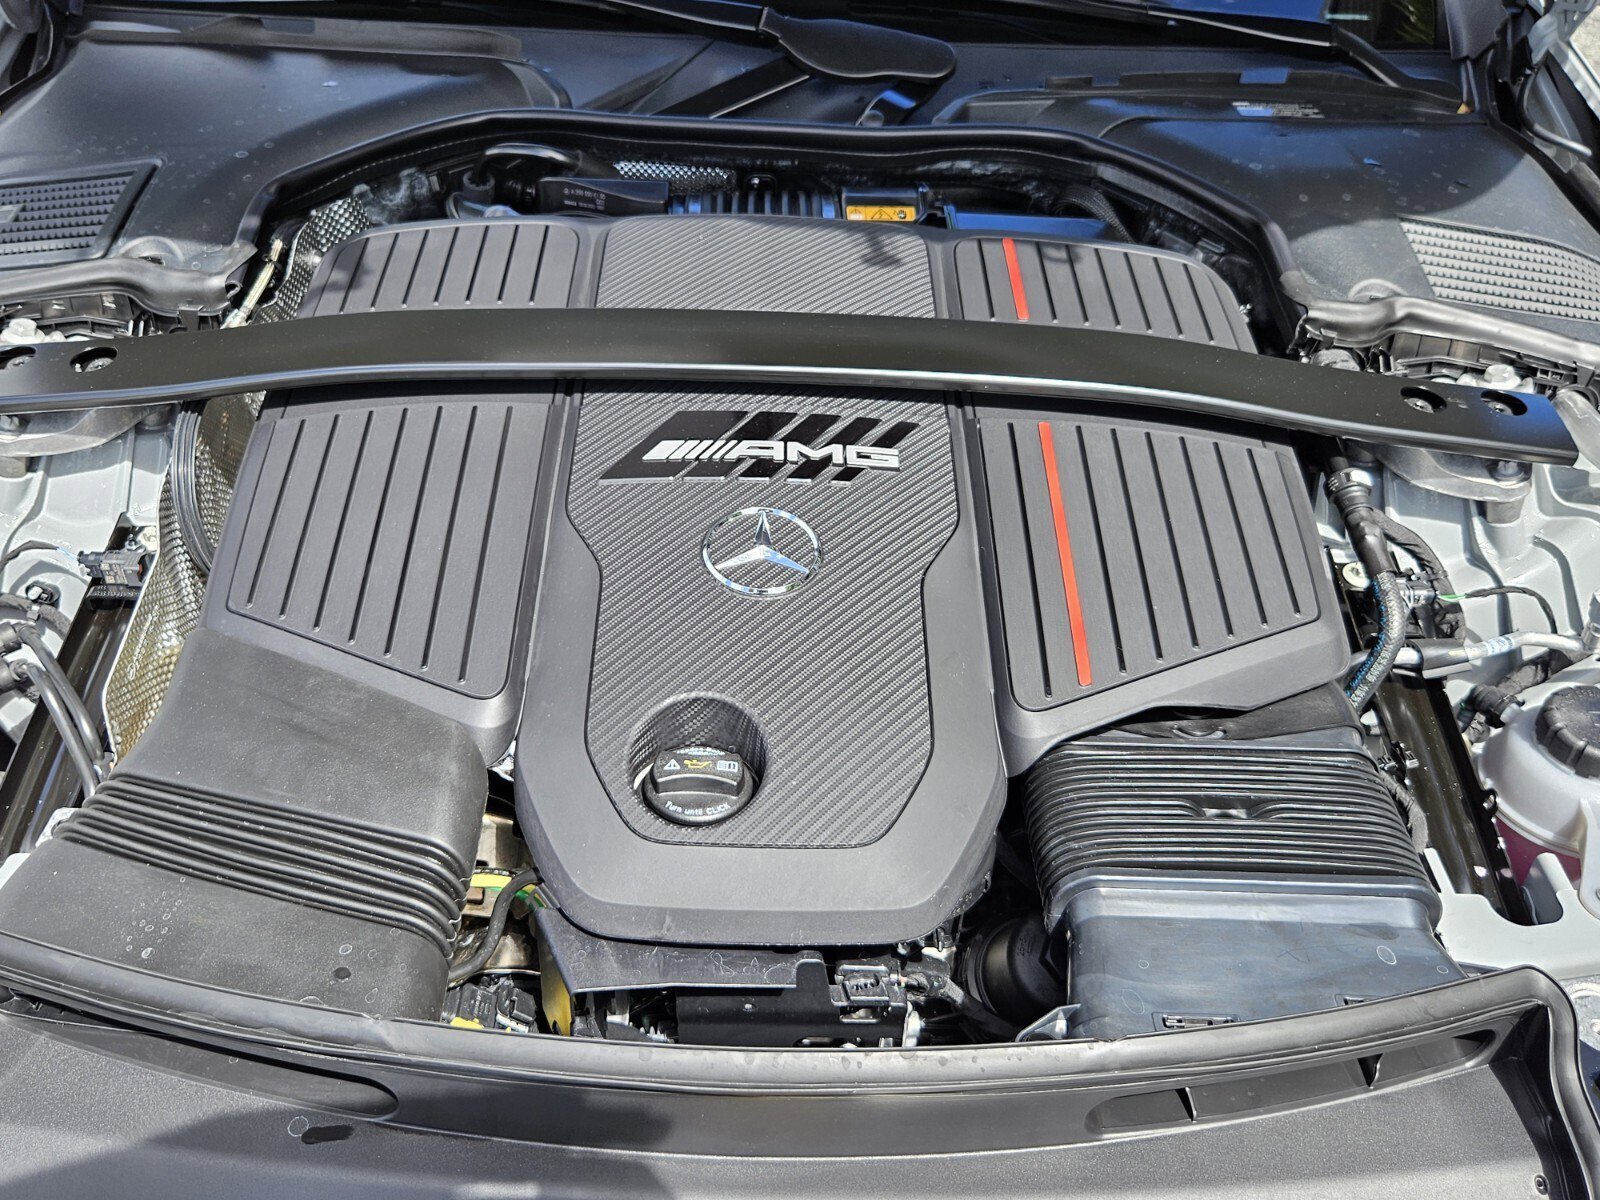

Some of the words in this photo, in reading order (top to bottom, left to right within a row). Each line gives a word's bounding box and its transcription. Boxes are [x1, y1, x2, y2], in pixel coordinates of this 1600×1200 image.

[723, 440, 901, 470] AMG
[665, 800, 682, 812] Turn
[684, 807, 703, 816] until
[706, 803, 731, 815] CLICK
